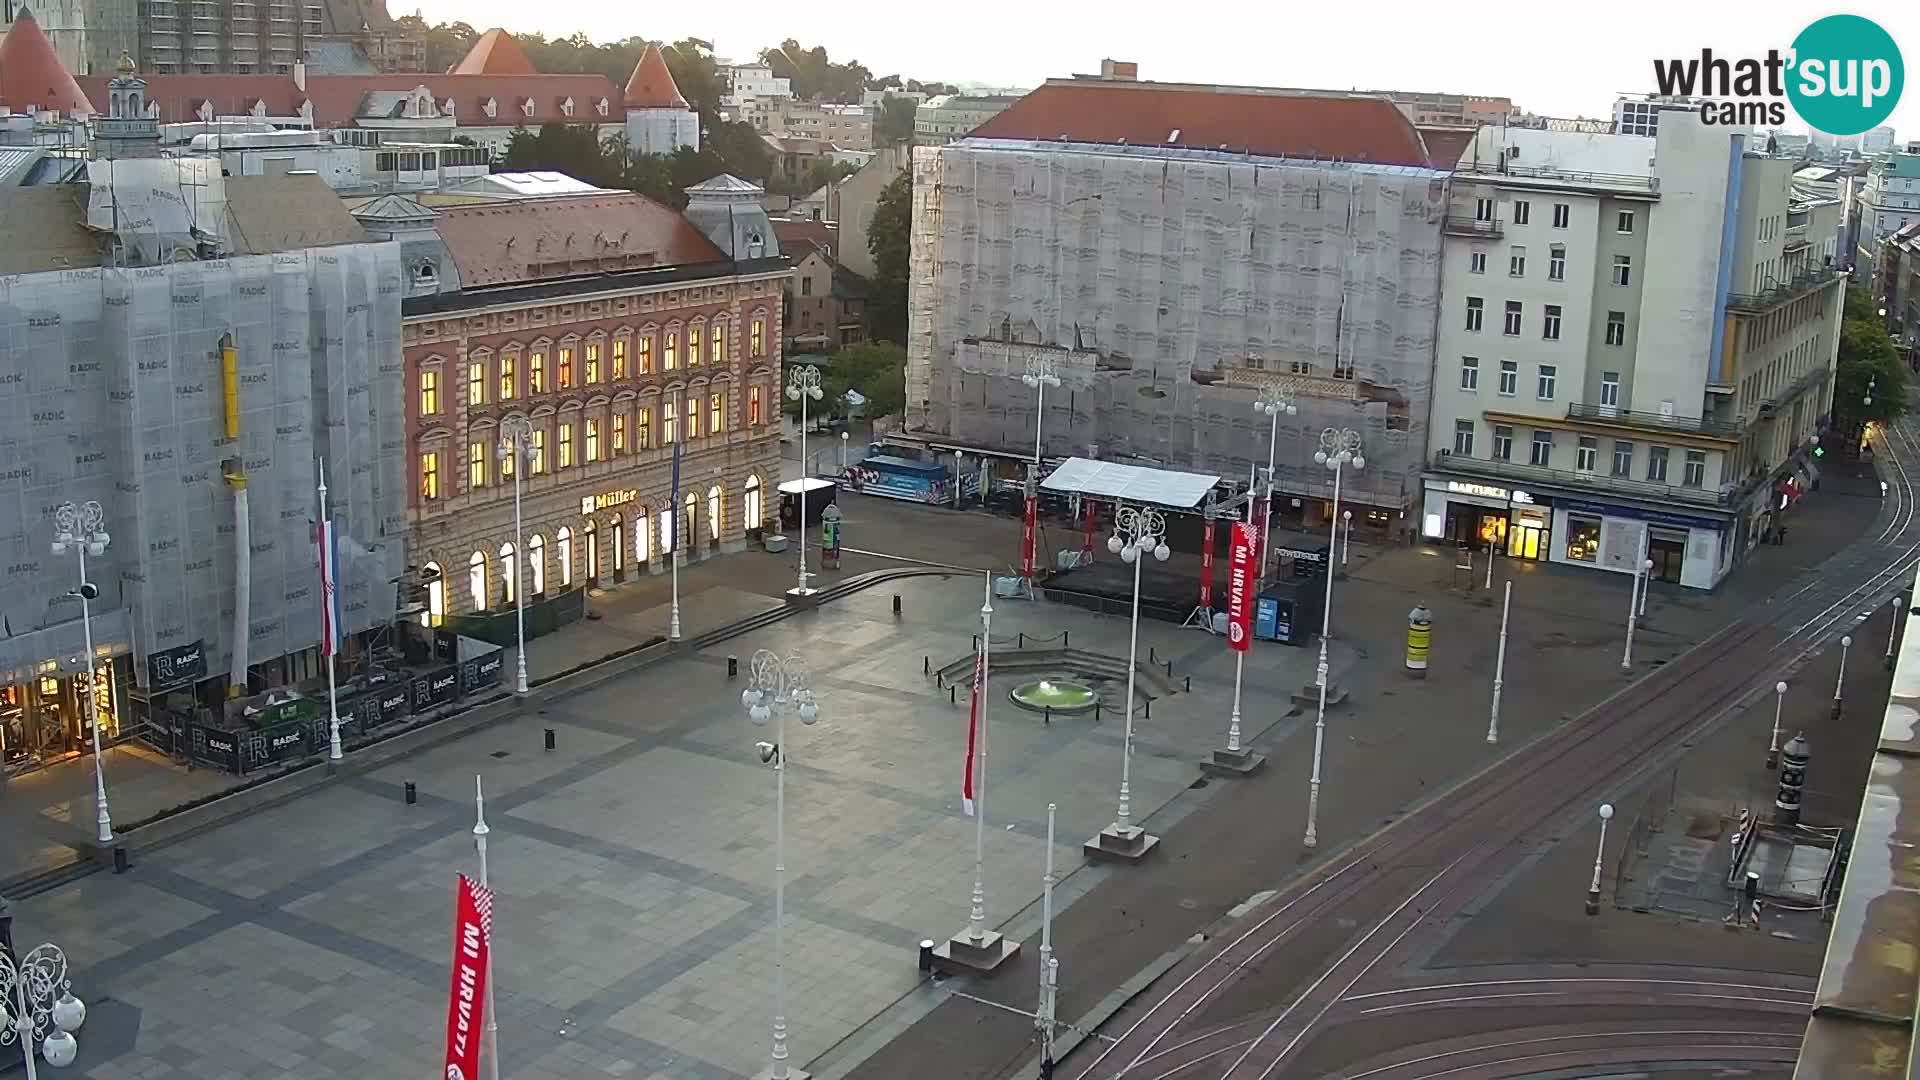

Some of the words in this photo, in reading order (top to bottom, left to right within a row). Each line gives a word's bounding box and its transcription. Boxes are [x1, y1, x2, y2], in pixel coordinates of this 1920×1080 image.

[595, 490, 637, 510] Müller
[1235, 545, 1248, 564] MI
[1231, 568, 1245, 617] HRVATI
[176, 649, 200, 666] RADIĆ
[383, 693, 406, 708] RADIĆ
[273, 731, 300, 748] RADIĆ
[463, 921, 479, 959] MI
[455, 963, 477, 1058] HRVATI
